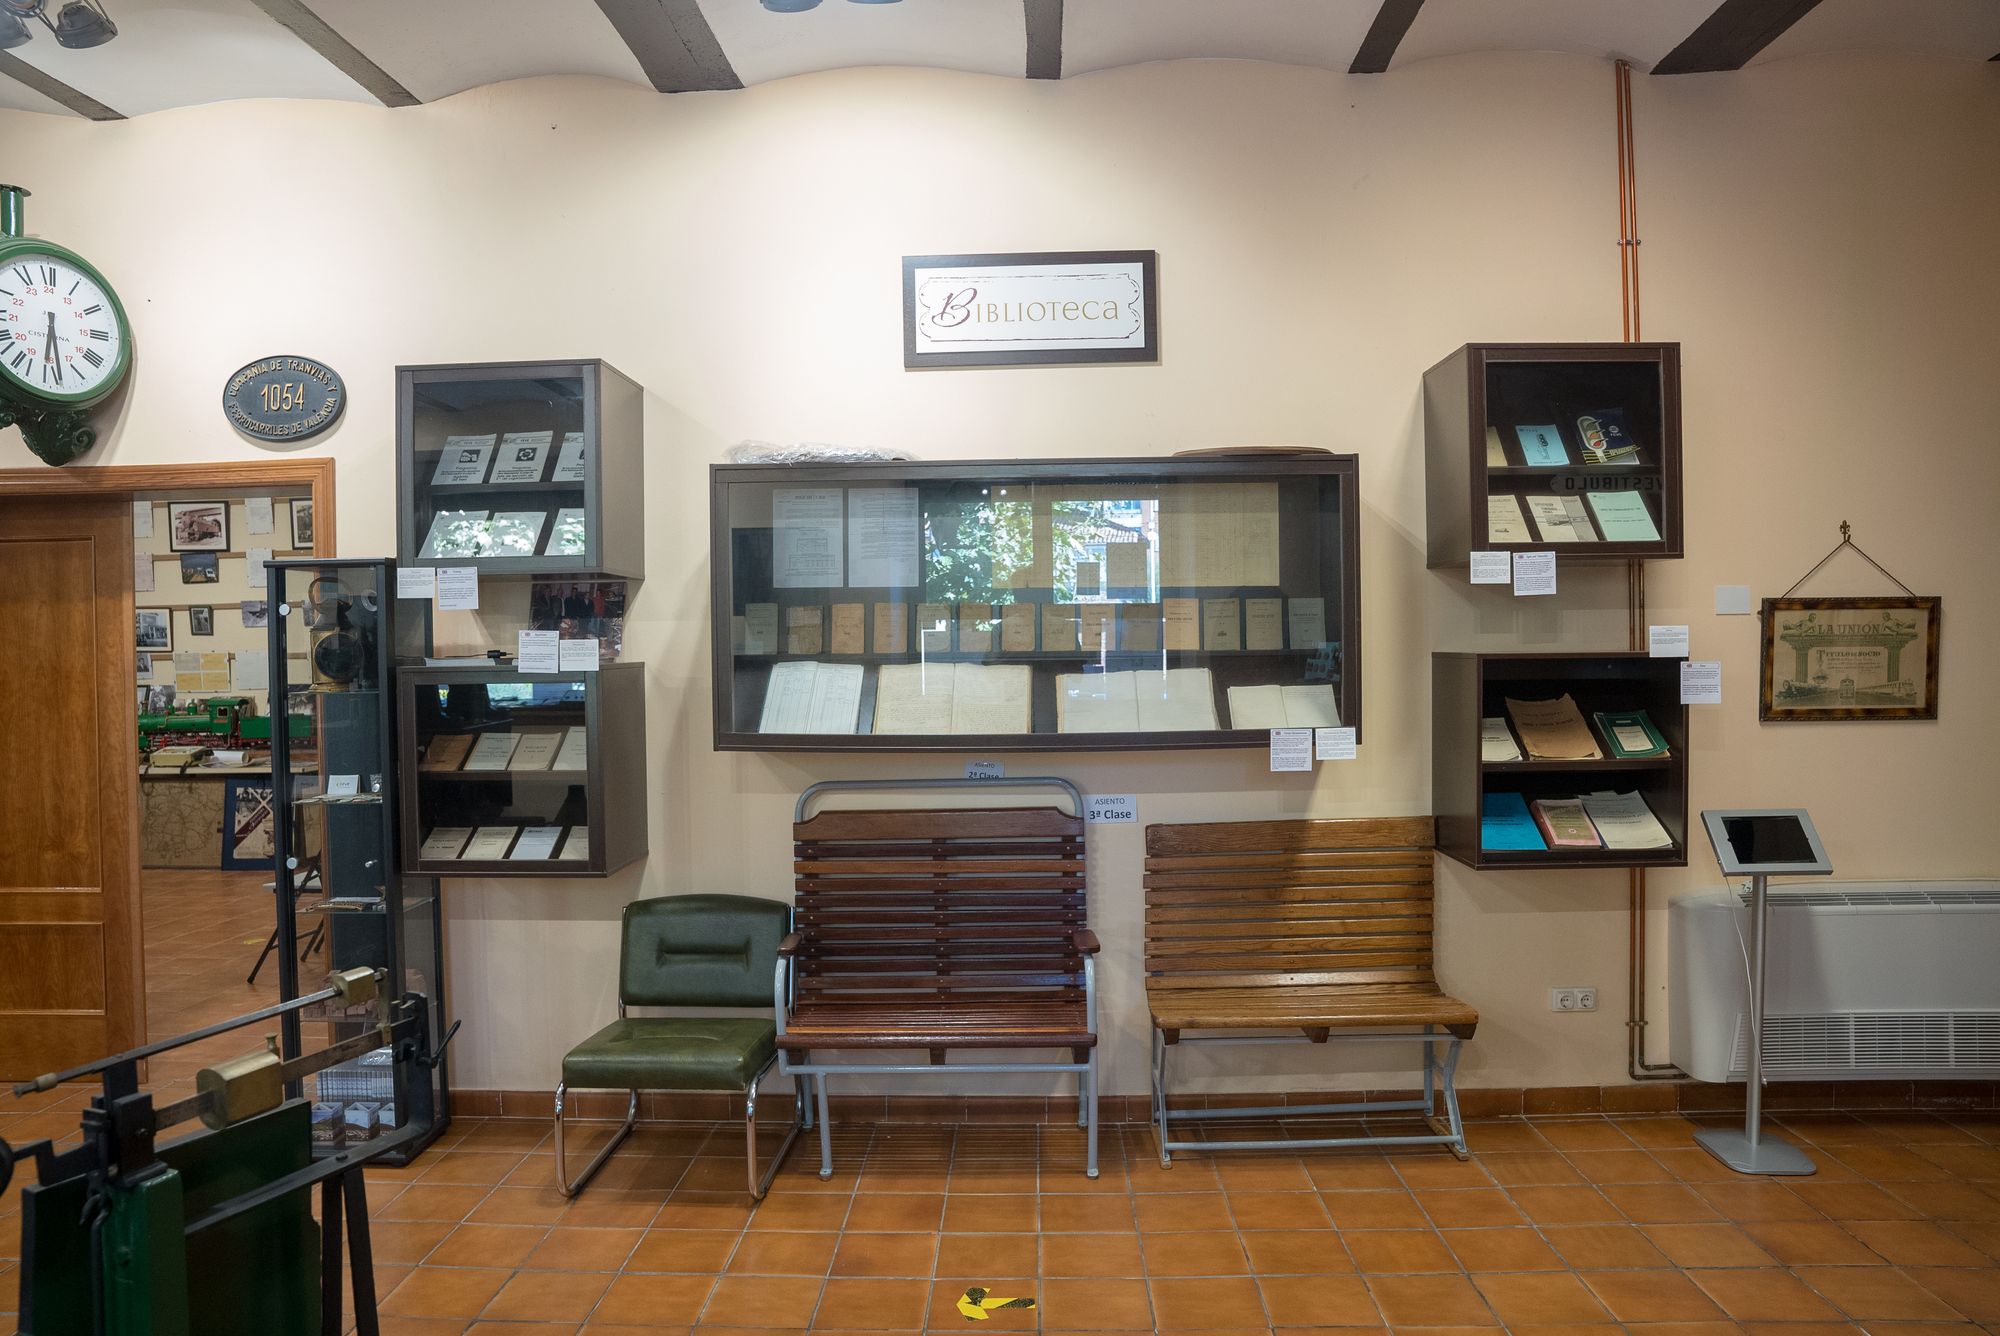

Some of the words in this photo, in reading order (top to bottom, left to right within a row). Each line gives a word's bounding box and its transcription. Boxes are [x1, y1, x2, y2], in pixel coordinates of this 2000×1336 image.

[26, 287, 38, 296] 23
[43, 286, 54, 294] 24
[12, 298, 24, 307] 22
[63, 297, 72, 305] 13
[8, 314, 18, 322] 21
[15, 333, 27, 341] 20
[28, 330, 70, 342] CISTNA
[79, 329, 88, 337] 15
[270, 360, 282, 371] DE
[288, 360, 331, 385] TRANVIAS
[326, 385, 338, 393] Y
[260, 382, 305, 412] 1054
[228, 402, 289, 436] FERROCARRILES
[291, 422, 302, 433] DE
[303, 397, 337, 430] VALENCIA
[1818, 624, 1834, 634] LA
[1837, 624, 1881, 634] UNION
[1089, 810, 1101, 820] 3ª
[1104, 809, 1131, 819] Clase
